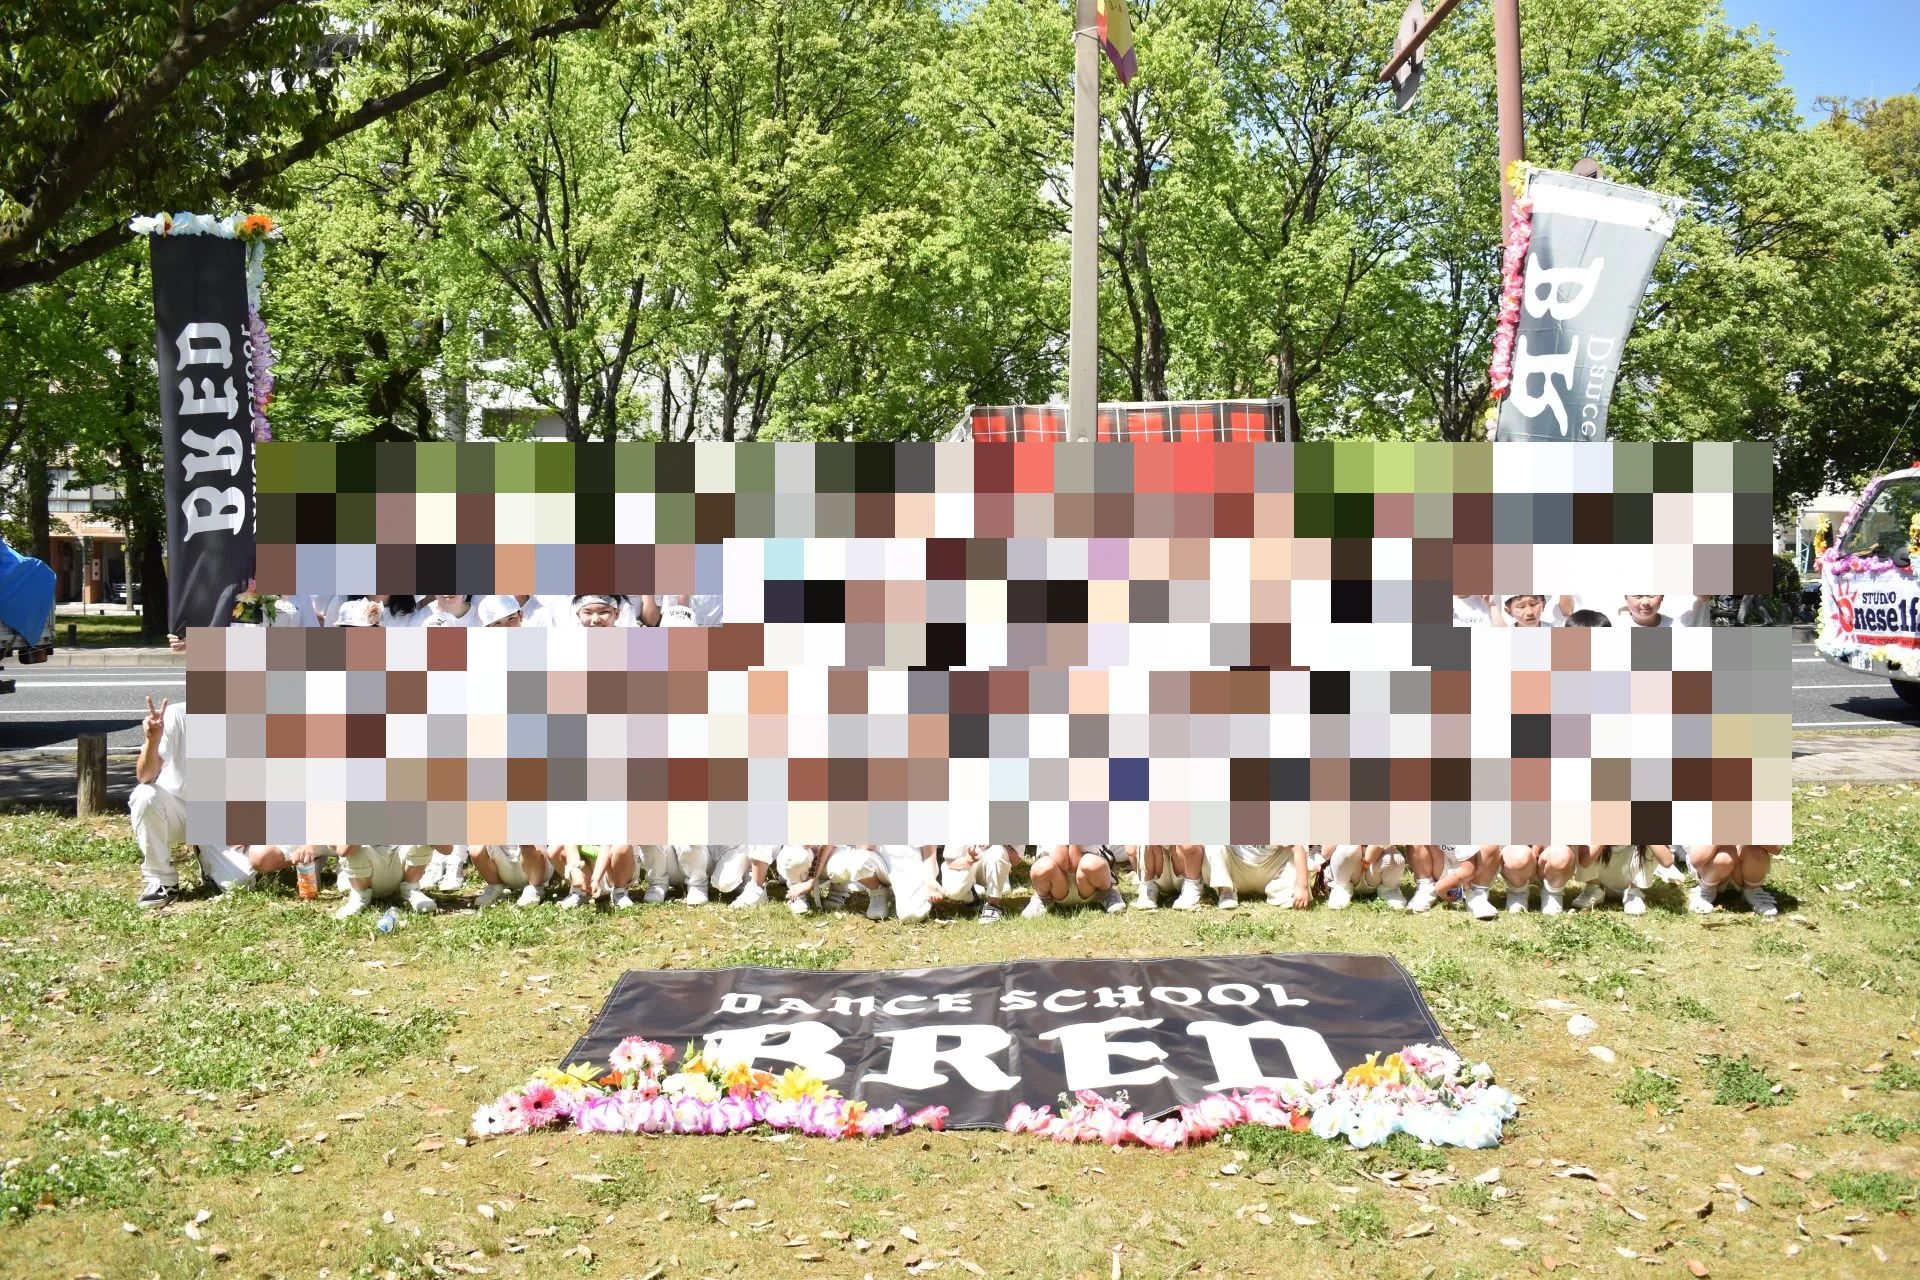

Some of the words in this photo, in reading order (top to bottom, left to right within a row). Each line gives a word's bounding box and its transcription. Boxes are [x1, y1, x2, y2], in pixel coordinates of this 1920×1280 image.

[177, 322, 246, 542] BRED
[1839, 597, 1920, 632] Oneself
[714, 992, 973, 1017] DANCE
[999, 983, 1310, 1013] SCHOOL
[702, 1016, 1343, 1092] BRED
